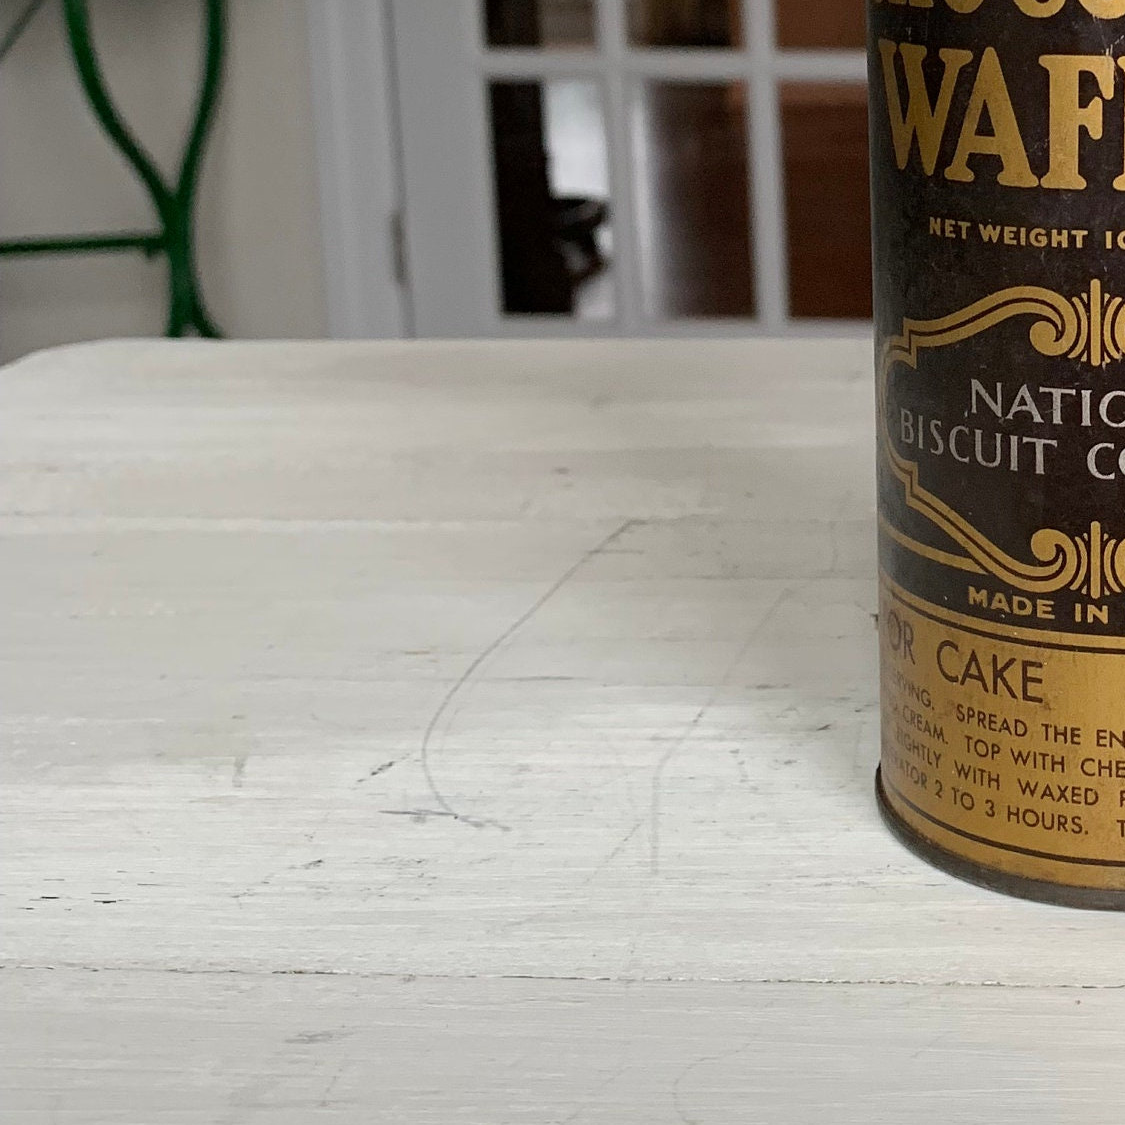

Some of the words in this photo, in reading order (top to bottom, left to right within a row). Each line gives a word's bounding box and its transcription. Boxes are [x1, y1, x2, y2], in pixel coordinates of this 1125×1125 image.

[929, 216, 970, 242] NET
[978, 219, 1089, 250] WEIGHT
[900, 407, 1058, 476] BISCUIT
[968, 585, 1056, 621] MADE
[1074, 603, 1109, 625] IN
[936, 639, 1044, 704] CAKE
[956, 704, 1028, 738] SPREAD
[1041, 723, 1082, 746] THE
[965, 735, 1001, 761] TOP
[1010, 747, 1066, 774] WITH
[954, 759, 1001, 791] WITH
[1017, 777, 1099, 806] WAXED
[935, 779, 944, 799] 2
[951, 786, 976, 812] TO
[984, 799, 997, 819] 3
[1007, 804, 1090, 836] HOURS.
